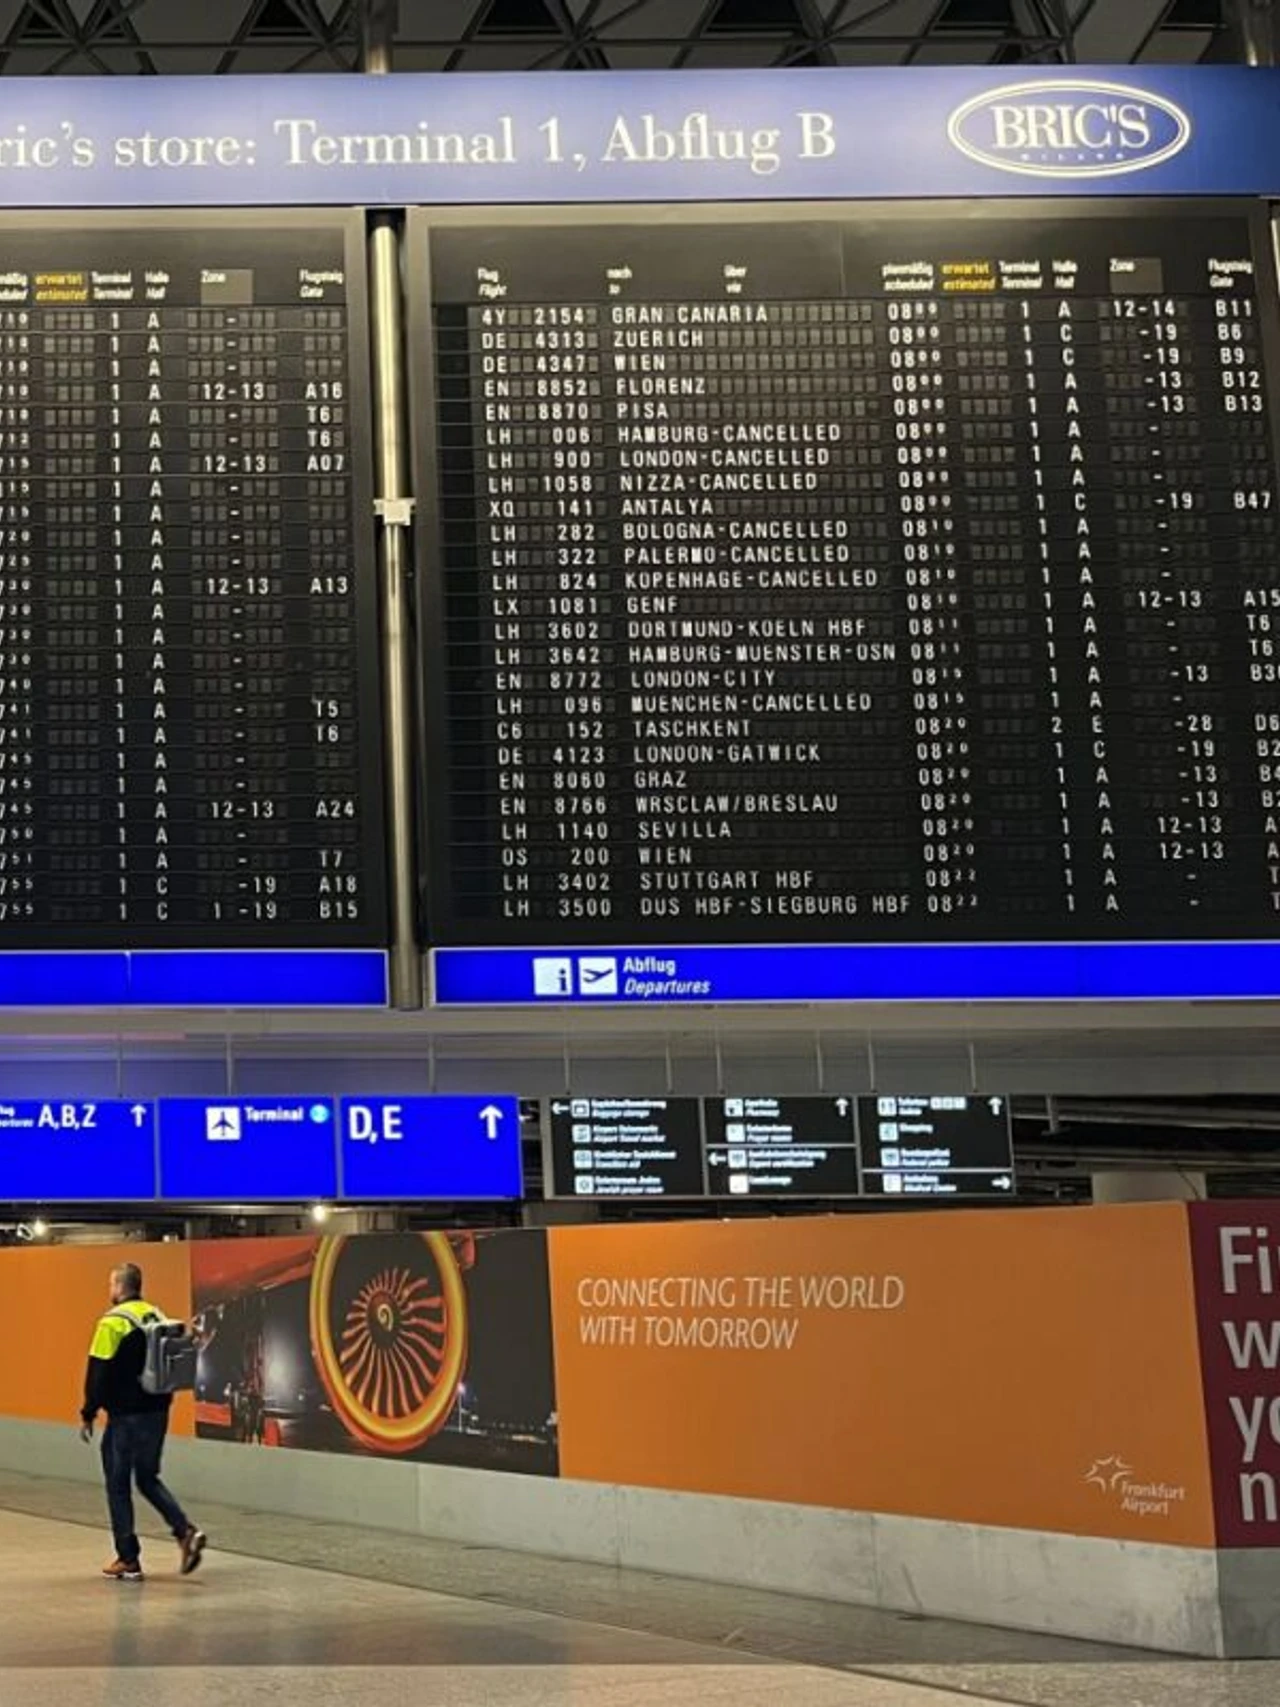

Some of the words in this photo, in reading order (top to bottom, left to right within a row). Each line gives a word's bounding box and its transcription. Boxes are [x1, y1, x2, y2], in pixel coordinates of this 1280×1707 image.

[991, 104, 1150, 148] BRIC'S
[114, 130, 256, 167] store:
[273, 117, 517, 165] Terminal
[538, 116, 586, 172] 1,
[602, 113, 781, 174] Abflug
[796, 113, 836, 158] B
[612, 307, 663, 323] GRAN
[678, 306, 768, 322] CANARIA
[614, 331, 704, 347] ZUERICH
[614, 355, 665, 371] WIEN
[306, 383, 342, 399] A16
[616, 379, 705, 395] FLORENZ
[1223, 373, 1260, 388] B12
[617, 403, 668, 419] PISA
[618, 426, 841, 442] HAMBURG-CANCELLED
[620, 449, 829, 466] LONDON-CANCELLED
[620, 474, 817, 491] NIZZA-CANCELLED
[622, 499, 714, 515] ANTALYA
[623, 523, 847, 539] BOLOGNA-CANCELLED
[625, 547, 848, 564] PALERMO-CANCELLED
[625, 571, 877, 589] KOPENHAGE-CANCELLED
[627, 596, 679, 614] GENF
[828, 620, 866, 637] HBF
[629, 646, 896, 662] HAMBURG-MUENSTER-OSN
[631, 671, 776, 688] LONDON-CITY
[632, 694, 872, 711] MUENCHEN-CANCELLED
[633, 720, 751, 737] TASCHKENT
[634, 745, 820, 763] LONDON-GATWICK
[635, 771, 687, 789] GRAZ
[316, 803, 355, 817] A24
[639, 822, 731, 838] SEVILLA
[639, 847, 692, 864] WIEN
[641, 872, 759, 890] STUTTGART
[776, 871, 814, 888] HBF
[320, 903, 357, 918] B15
[641, 898, 680, 916] DUS
[696, 897, 857, 915] HBF-SIEGBURG
[873, 896, 910, 912] HBF
[623, 956, 675, 976] Abflug
[624, 977, 710, 997] Departures
[38, 1104, 97, 1130] A,B,Z
[244, 1106, 304, 1122] Terminal
[349, 1105, 403, 1145] D,E
[577, 1277, 736, 1308] CONNECTING
[743, 1277, 793, 1308] THE
[799, 1276, 905, 1309] WORLD
[579, 1316, 637, 1346] WITH
[645, 1317, 800, 1350] TOMORROW
[1122, 1481, 1185, 1500] Frankfurt
[1122, 1498, 1168, 1516] Airport
